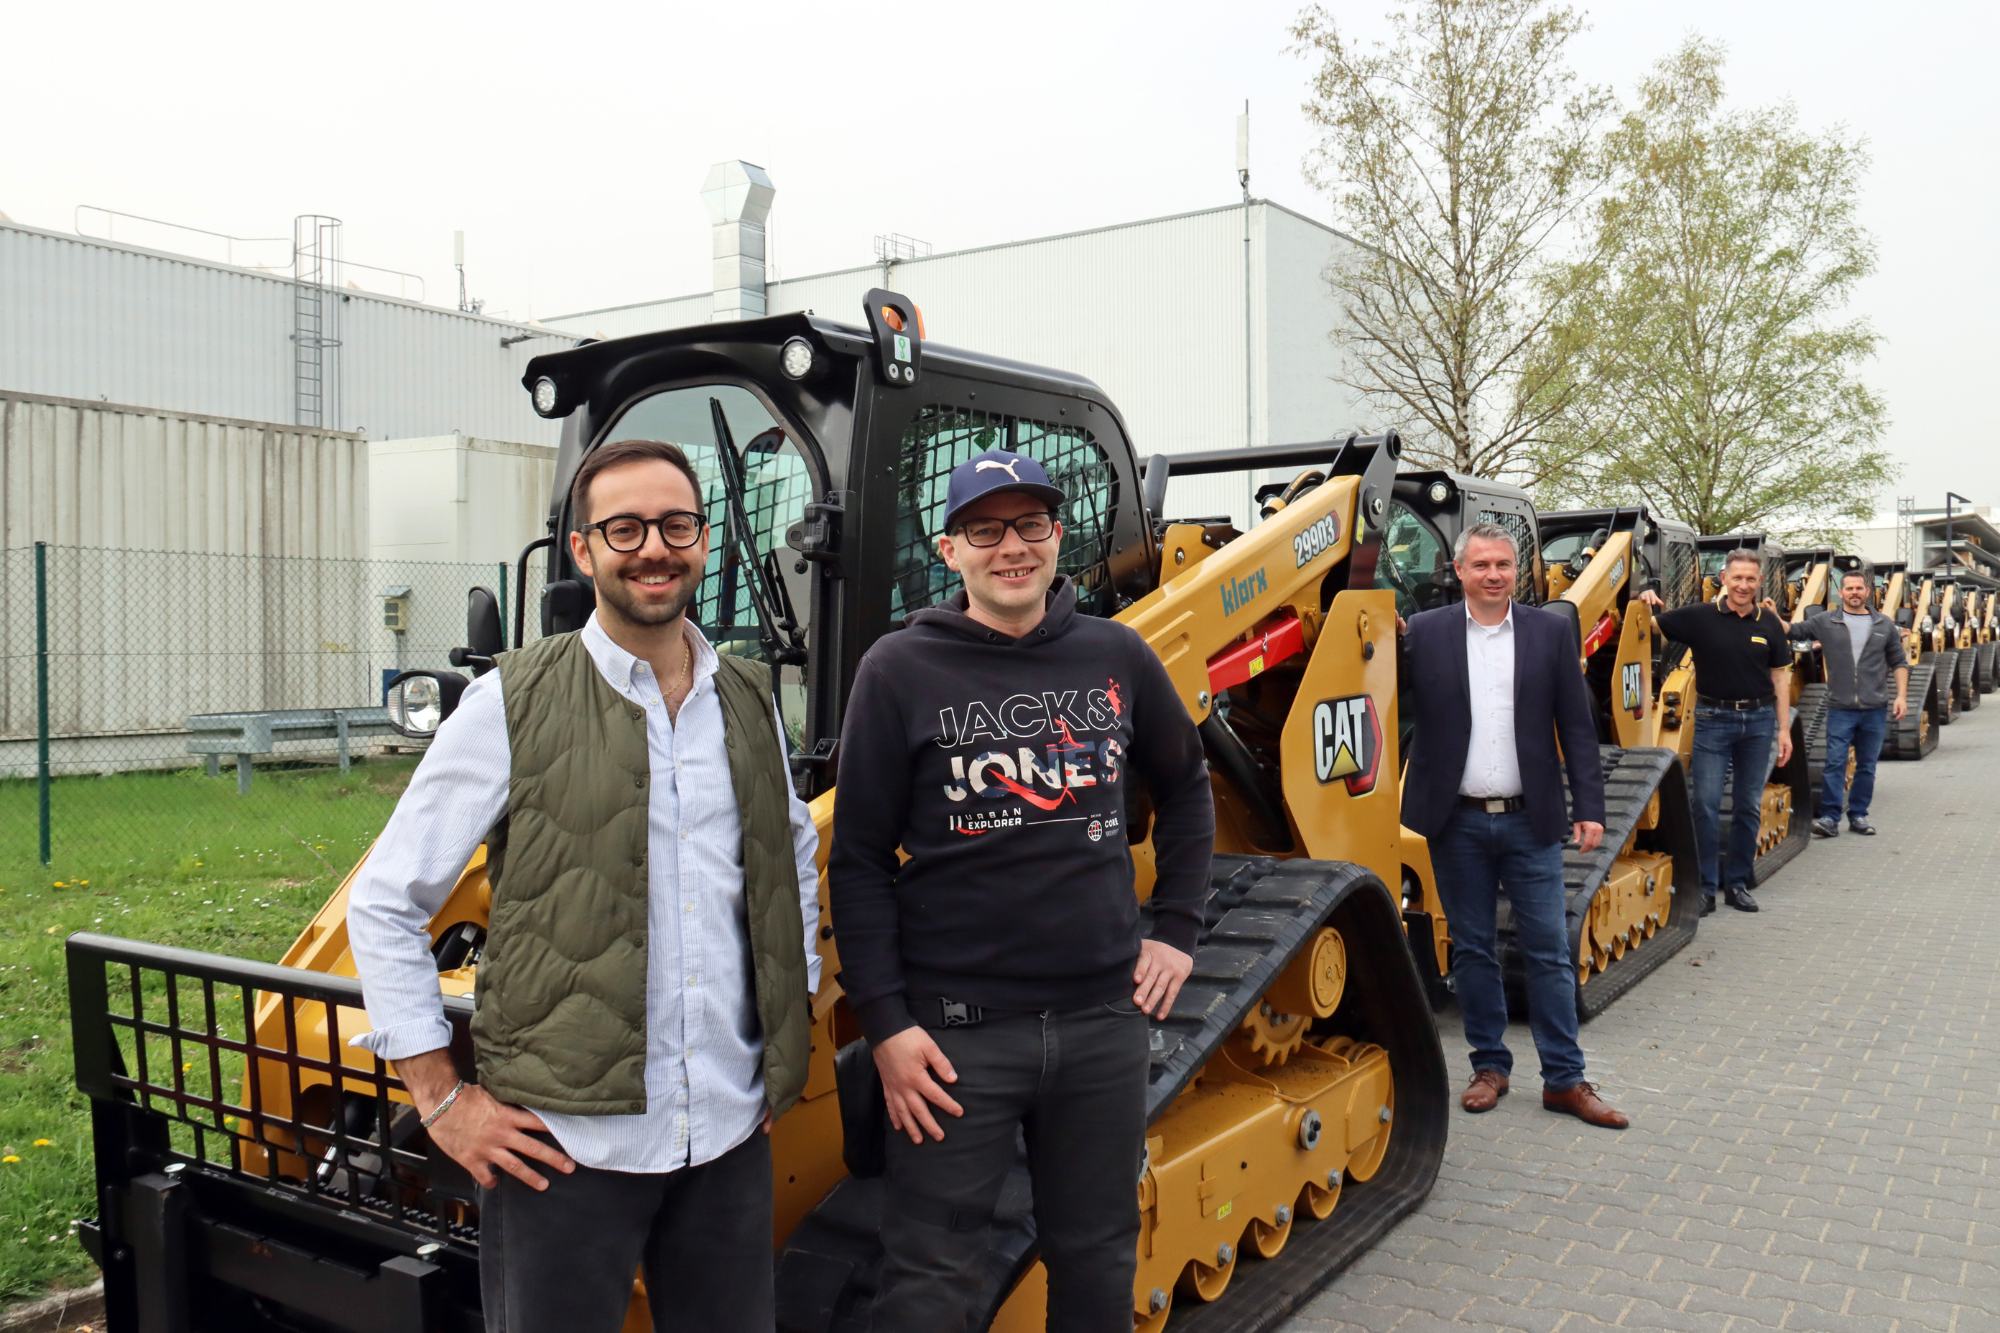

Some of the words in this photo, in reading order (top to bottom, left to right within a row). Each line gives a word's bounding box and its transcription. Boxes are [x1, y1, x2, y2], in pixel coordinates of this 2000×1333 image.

[1294, 514, 1335, 567] 299D3
[1220, 566, 1268, 618] klarx
[1622, 663, 1641, 709] CAT
[1314, 697, 1366, 781] CAT
[943, 738, 1122, 801] JONES
[965, 807, 1022, 820] URBAN
[968, 817, 1022, 830] EXPLORER
[1104, 817, 1119, 828] CORE
